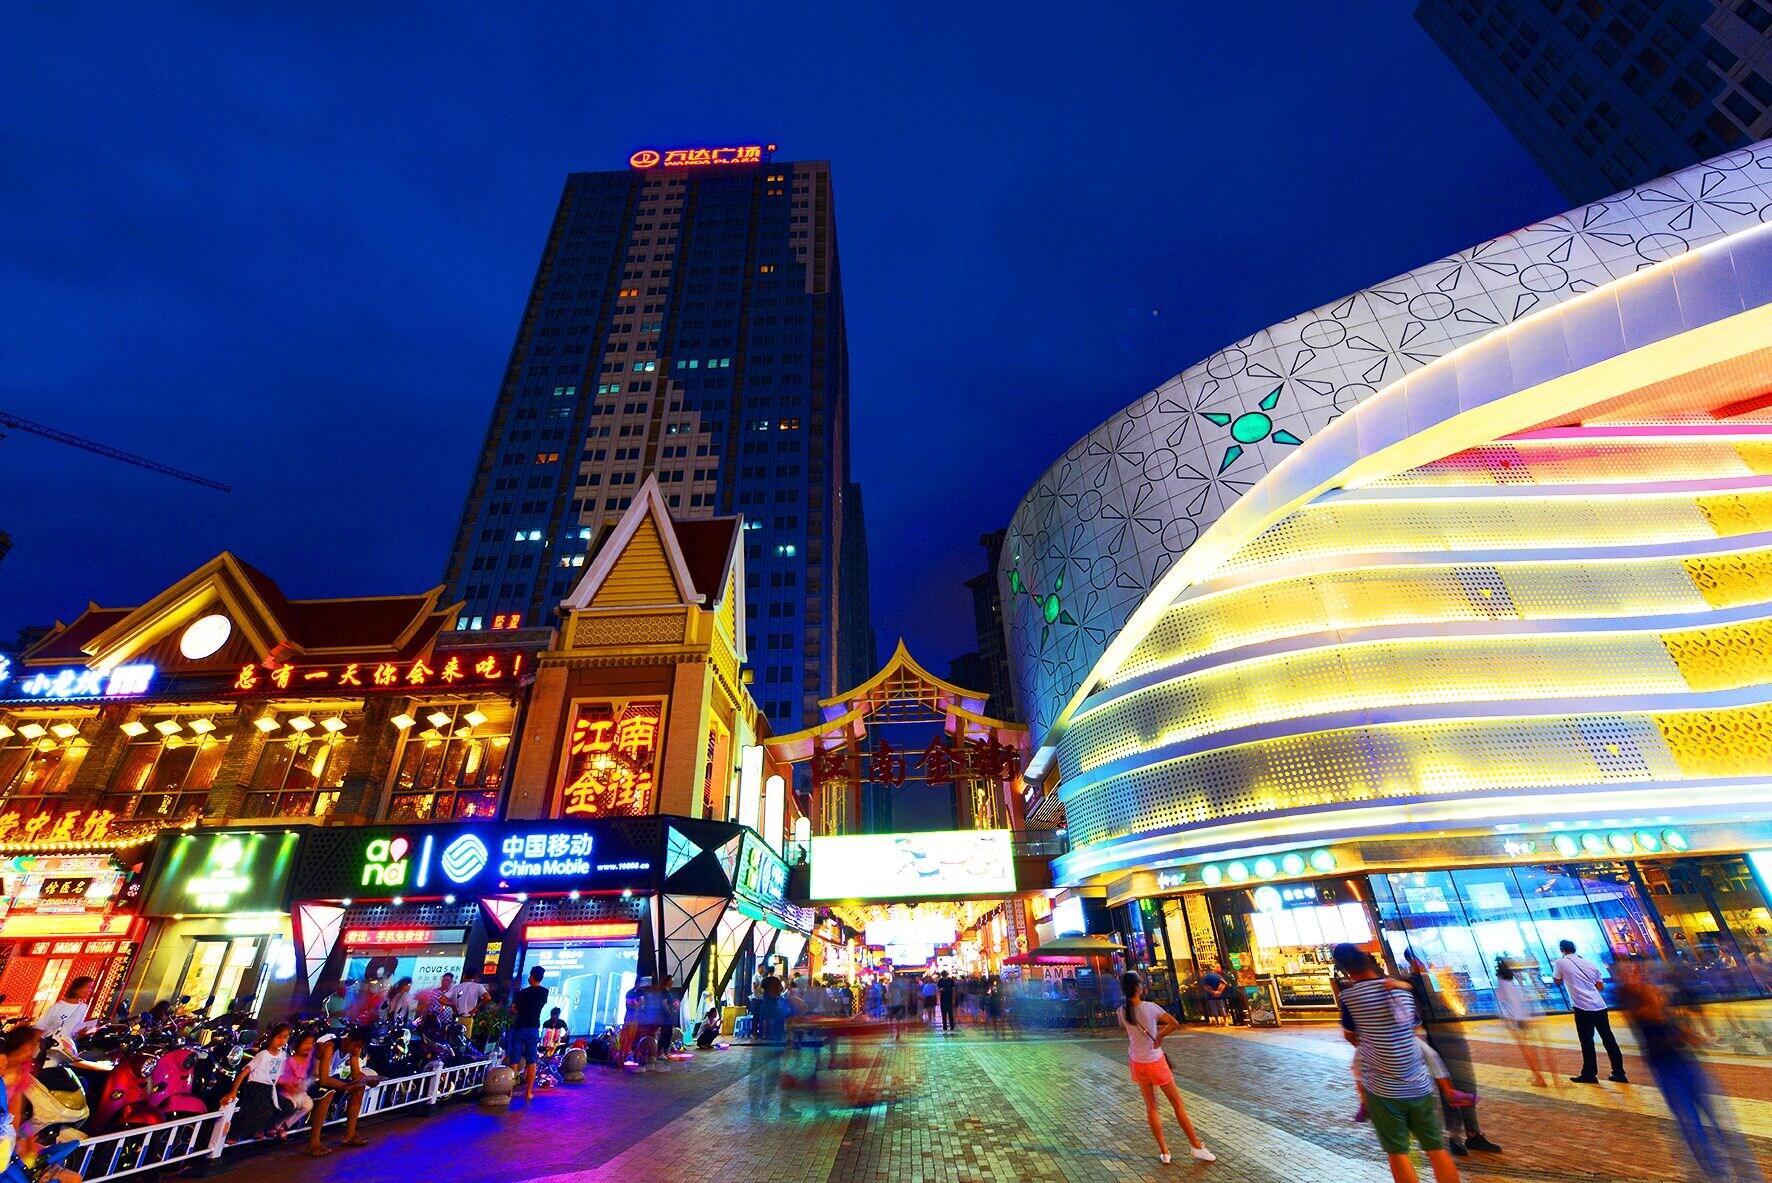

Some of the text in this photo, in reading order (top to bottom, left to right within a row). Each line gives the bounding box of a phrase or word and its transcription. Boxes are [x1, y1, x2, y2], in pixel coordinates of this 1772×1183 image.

[665, 146, 760, 160] 万达广场
[572, 715, 659, 760] 江南
[564, 771, 653, 815] 金街
[502, 833, 594, 859] 中国移动
[500, 858, 591, 876] China Mobile
[419, 965, 443, 973] nova
